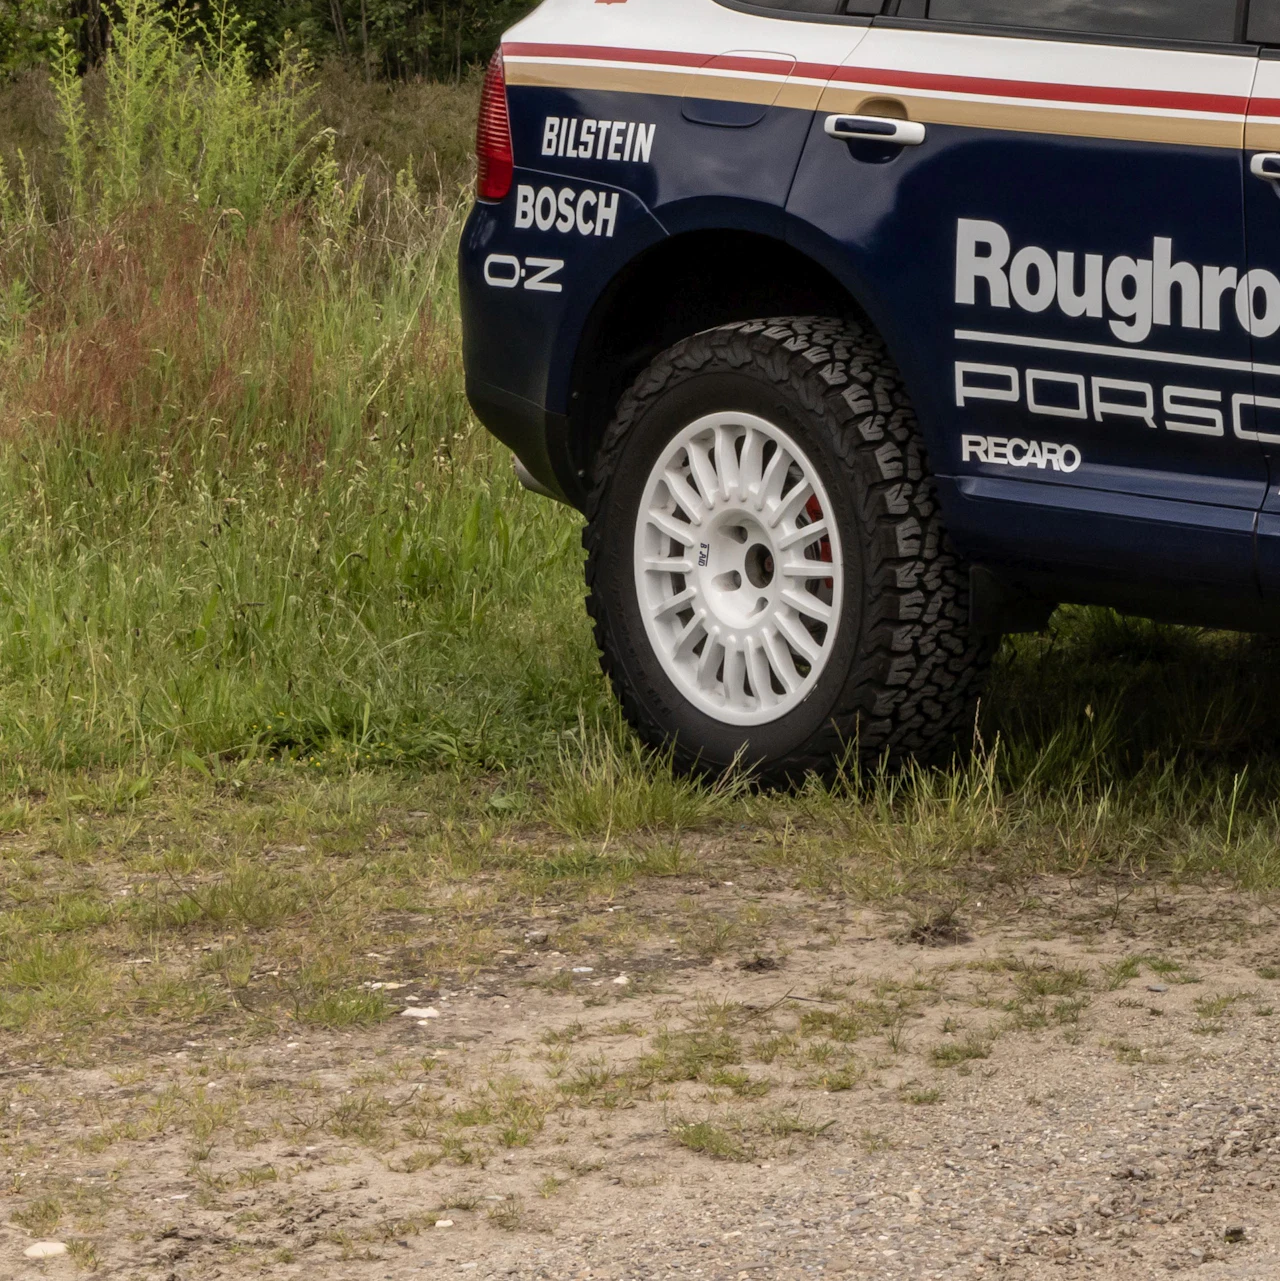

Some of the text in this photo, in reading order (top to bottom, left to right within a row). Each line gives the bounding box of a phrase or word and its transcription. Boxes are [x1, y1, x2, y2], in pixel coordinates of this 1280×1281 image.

[541, 116, 656, 163] BILSTEIN
[515, 184, 619, 237] BOSCH
[961, 433, 1081, 473] RECARO
